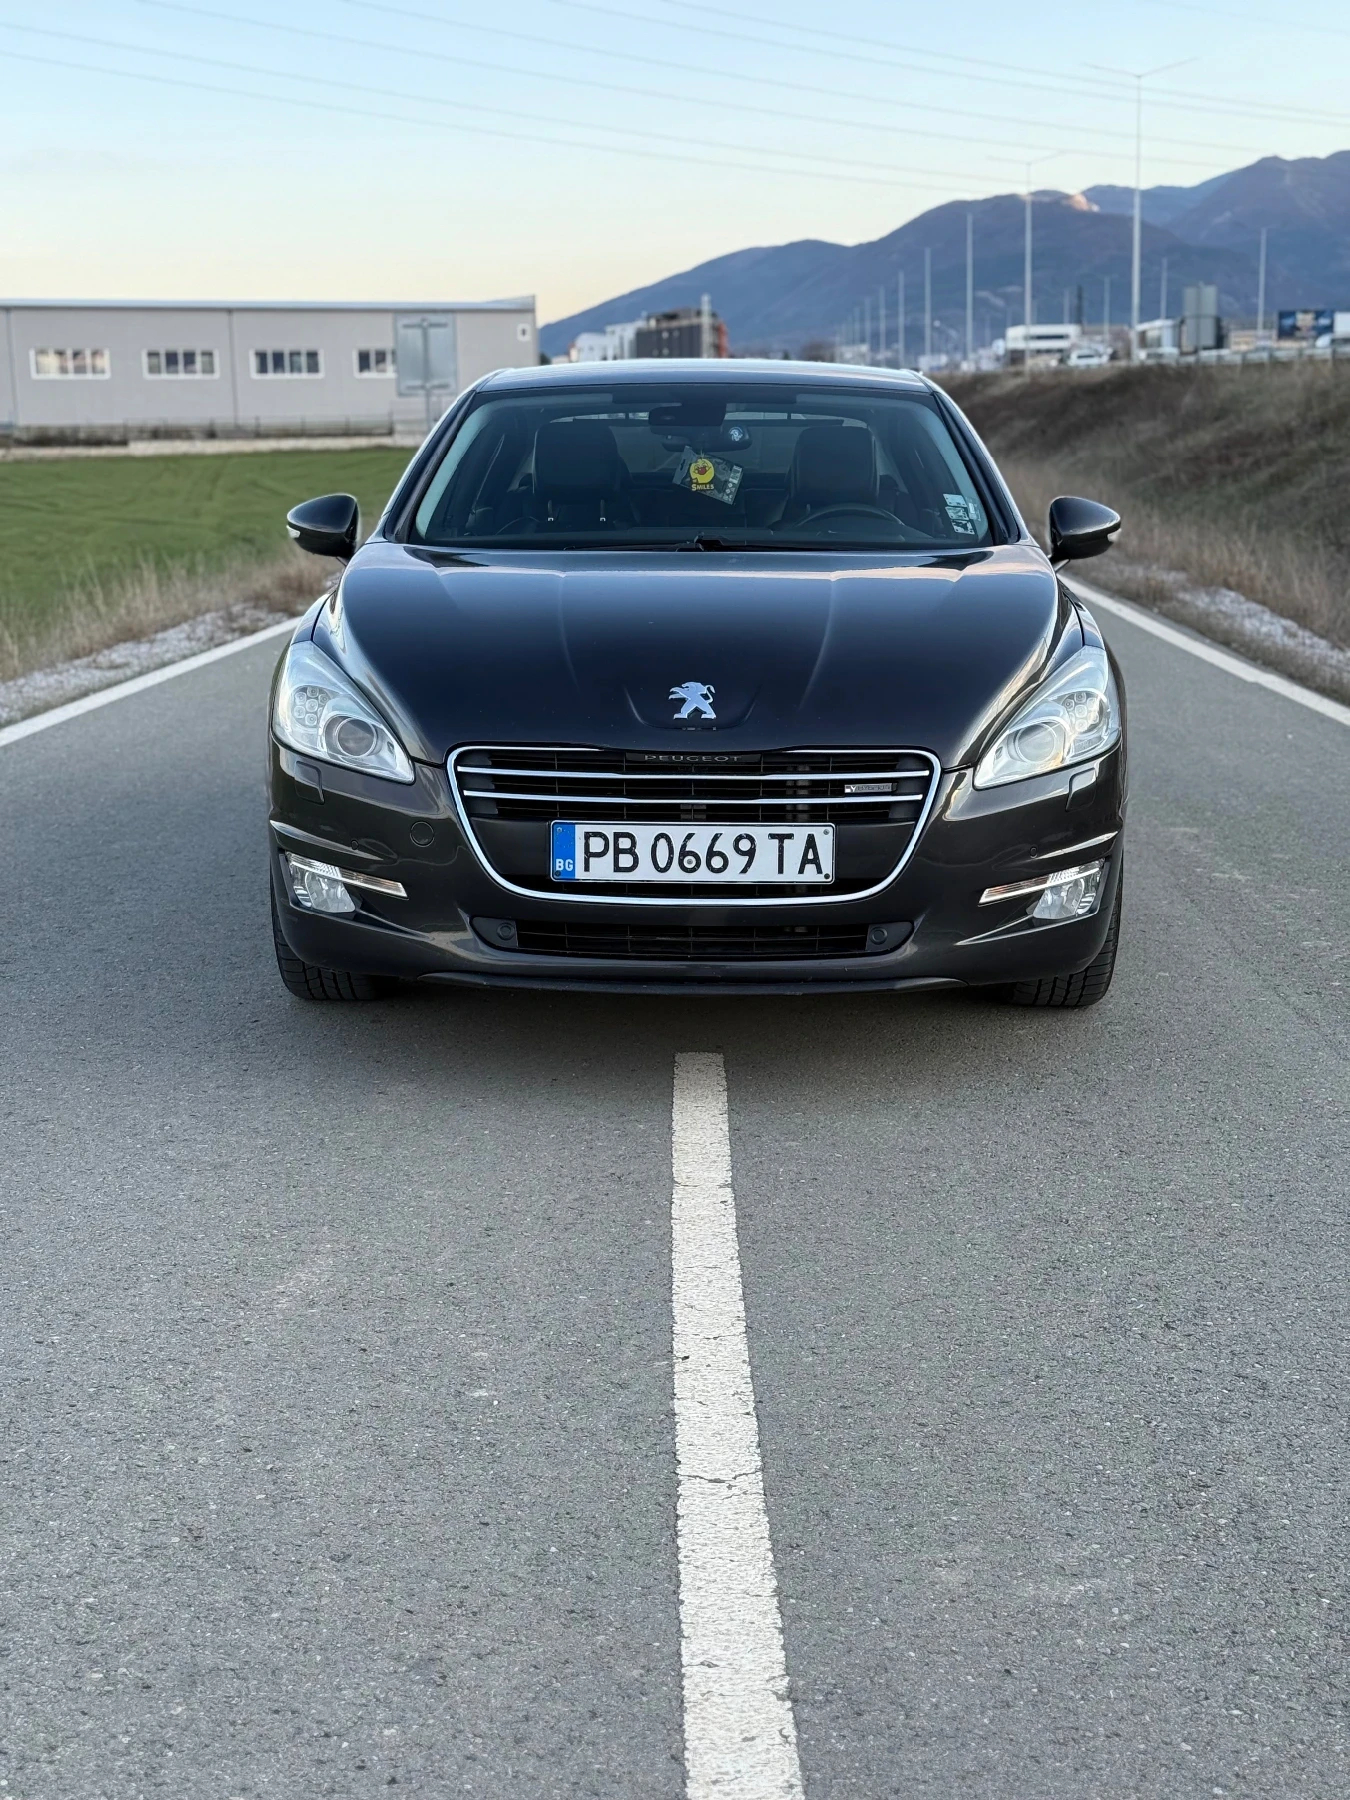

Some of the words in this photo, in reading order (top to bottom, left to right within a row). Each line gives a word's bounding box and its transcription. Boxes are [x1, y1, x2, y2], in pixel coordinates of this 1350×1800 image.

[555, 858, 574, 871] BG
[583, 831, 639, 873] PB
[650, 832, 757, 875] 0669
[767, 832, 824, 875] TA
